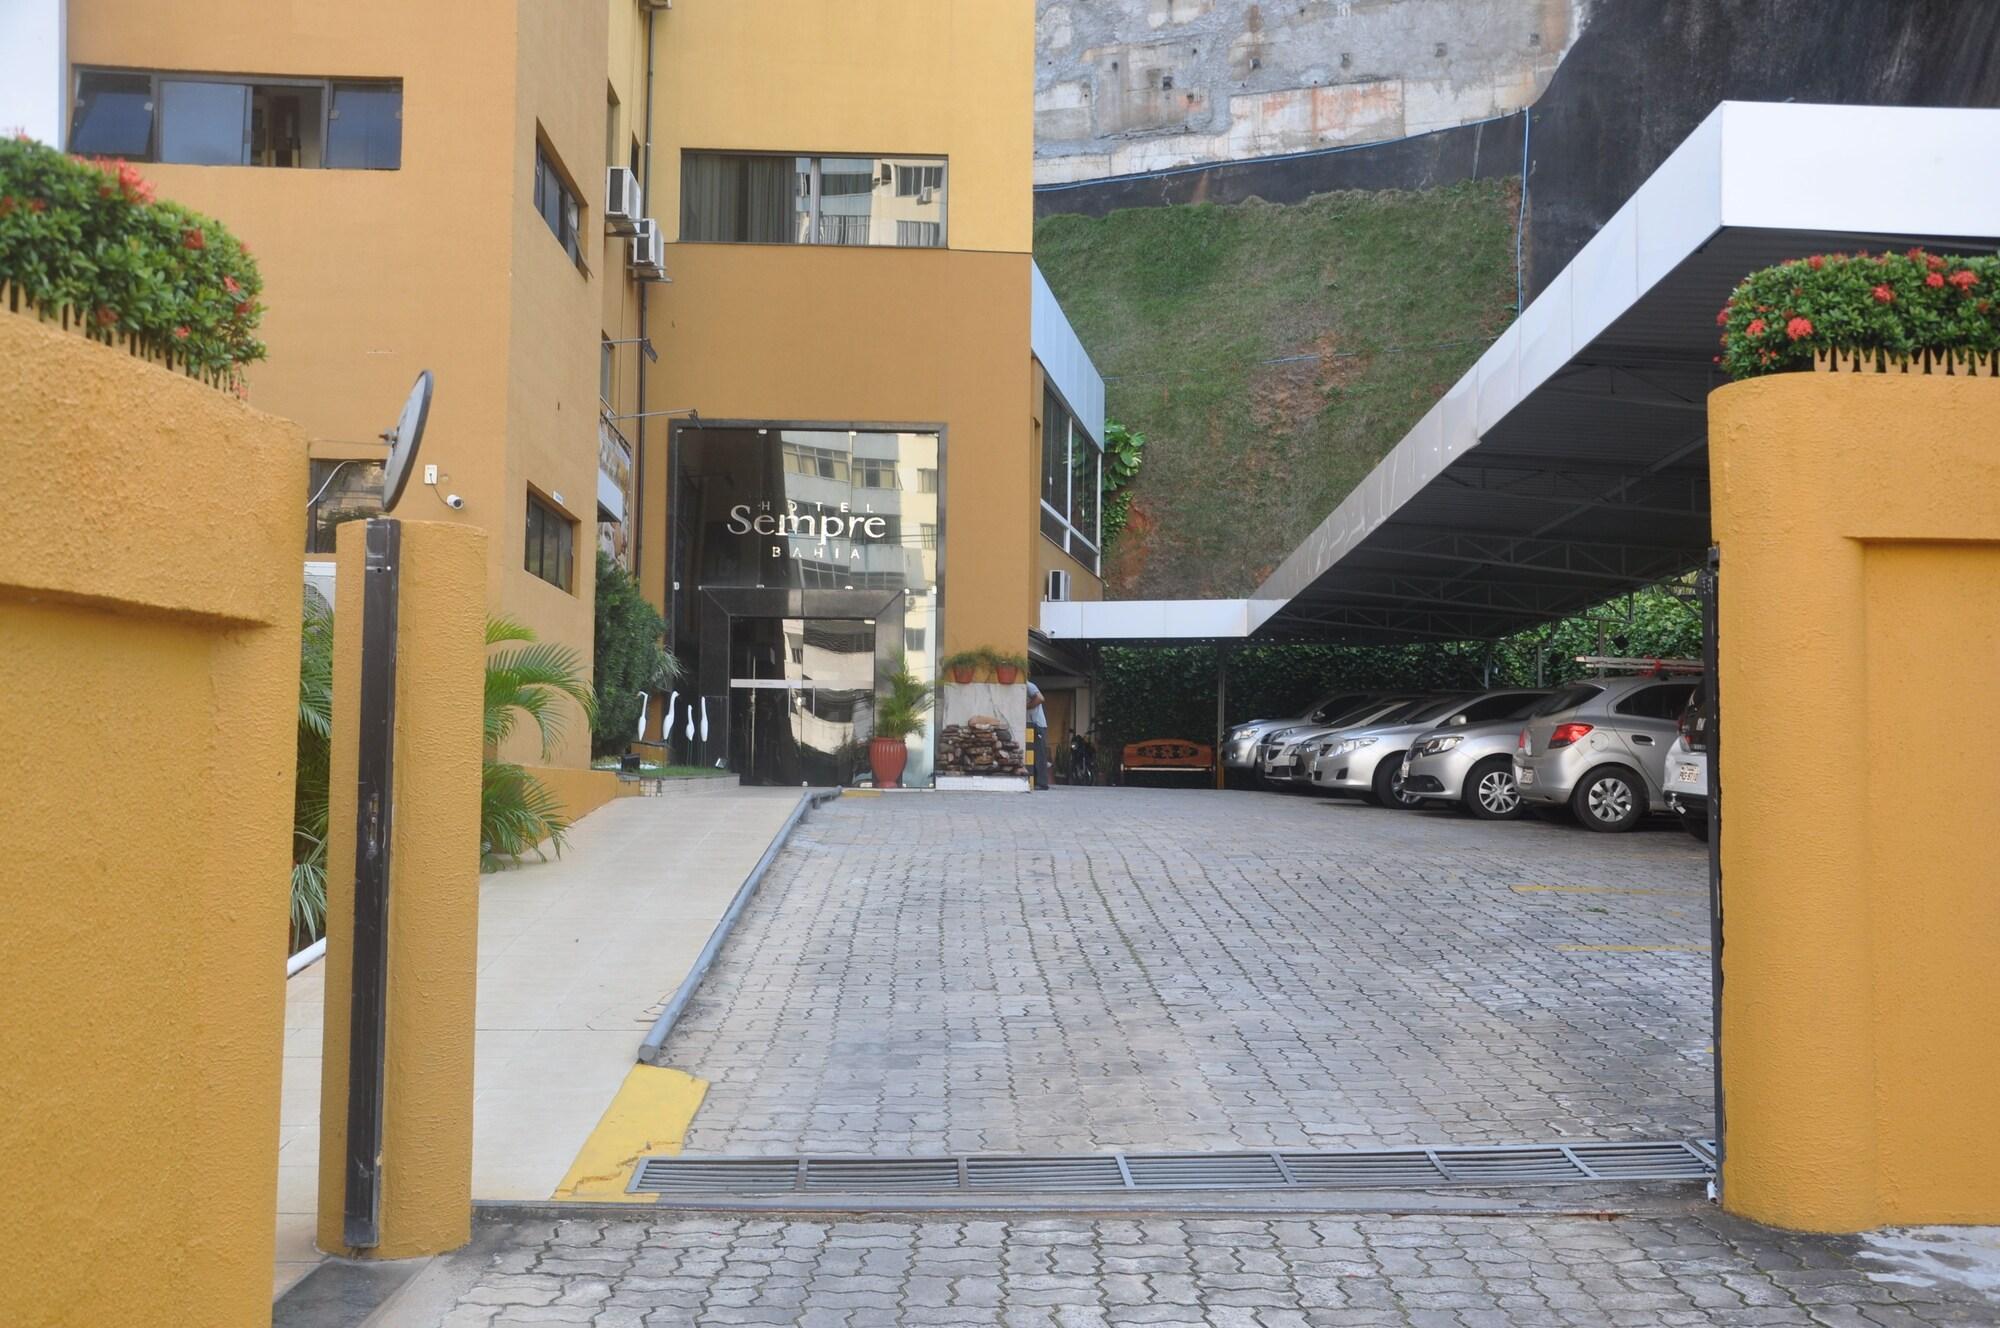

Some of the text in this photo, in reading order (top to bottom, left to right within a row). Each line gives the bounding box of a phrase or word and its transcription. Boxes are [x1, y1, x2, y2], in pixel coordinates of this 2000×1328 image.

[761, 501, 874, 513] HOTEL
[727, 504, 887, 546] Sempre
[772, 546, 861, 559] BAHIA
